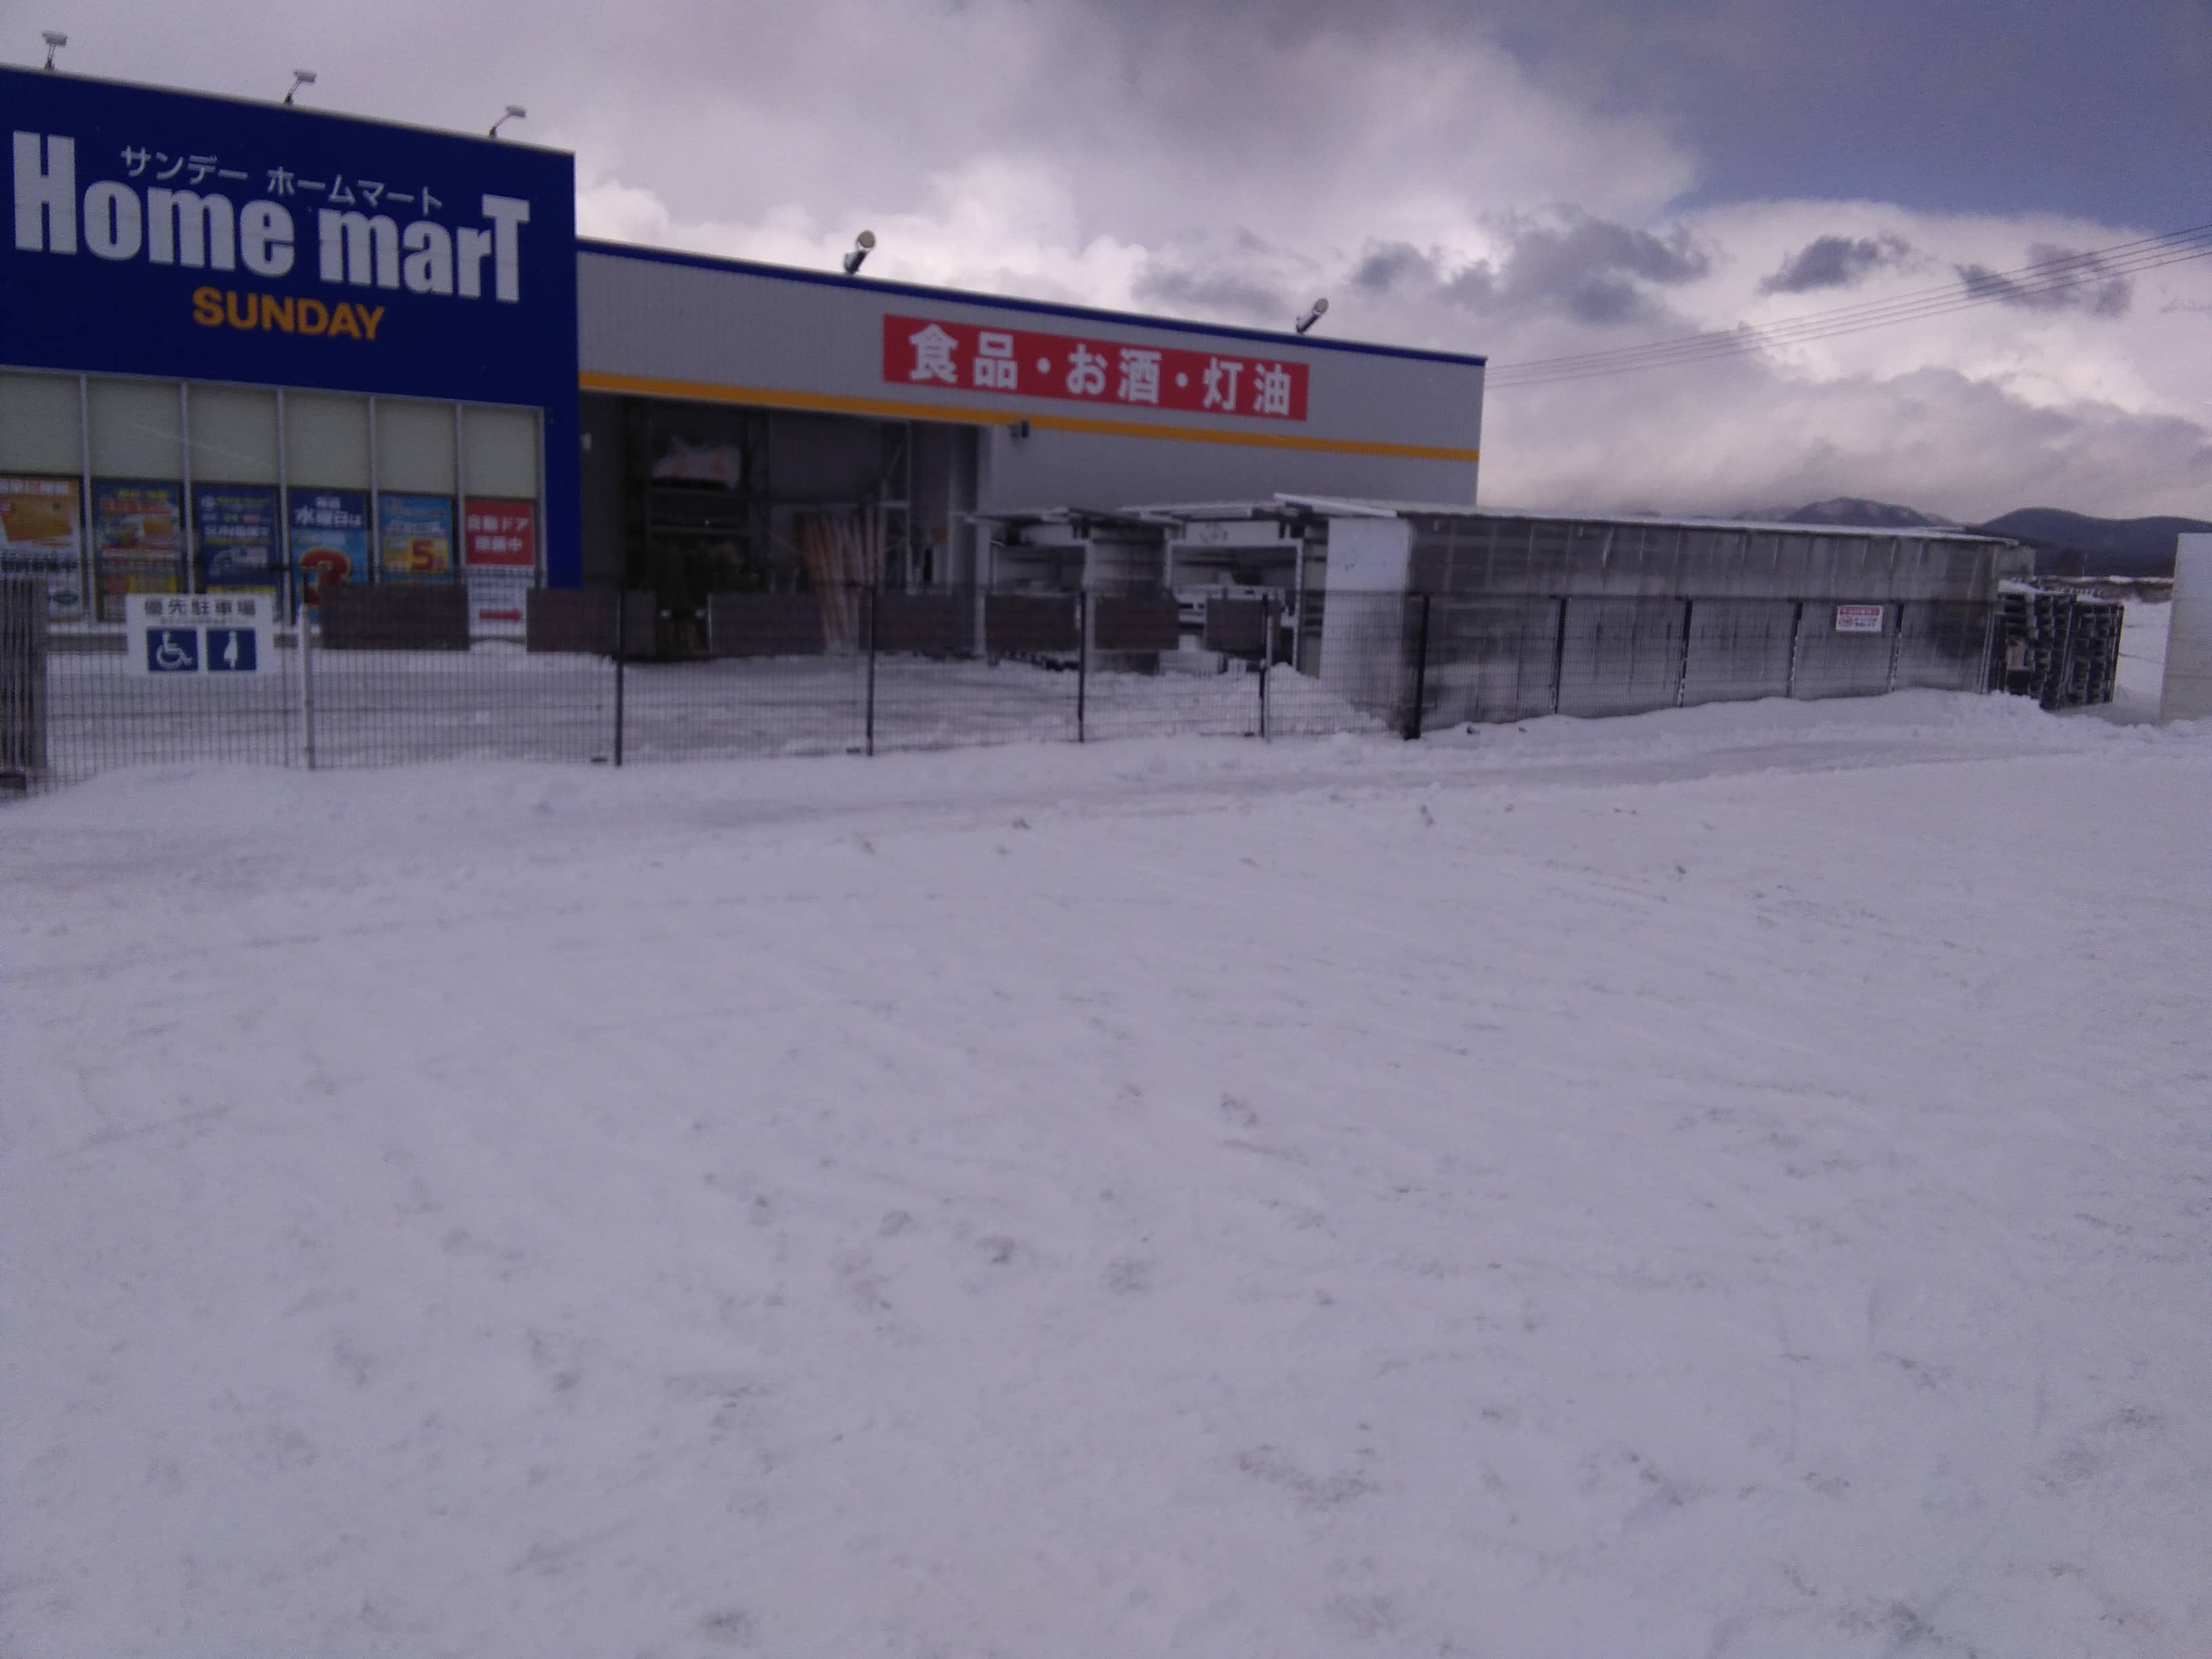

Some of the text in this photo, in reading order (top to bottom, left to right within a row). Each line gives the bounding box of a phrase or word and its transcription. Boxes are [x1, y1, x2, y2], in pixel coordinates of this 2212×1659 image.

[12, 130, 295, 276] Home
[121, 144, 443, 216] サンデー ホームマート
[191, 285, 386, 341] SUNDAY
[908, 323, 1291, 415] 食品・お酒・灯油
